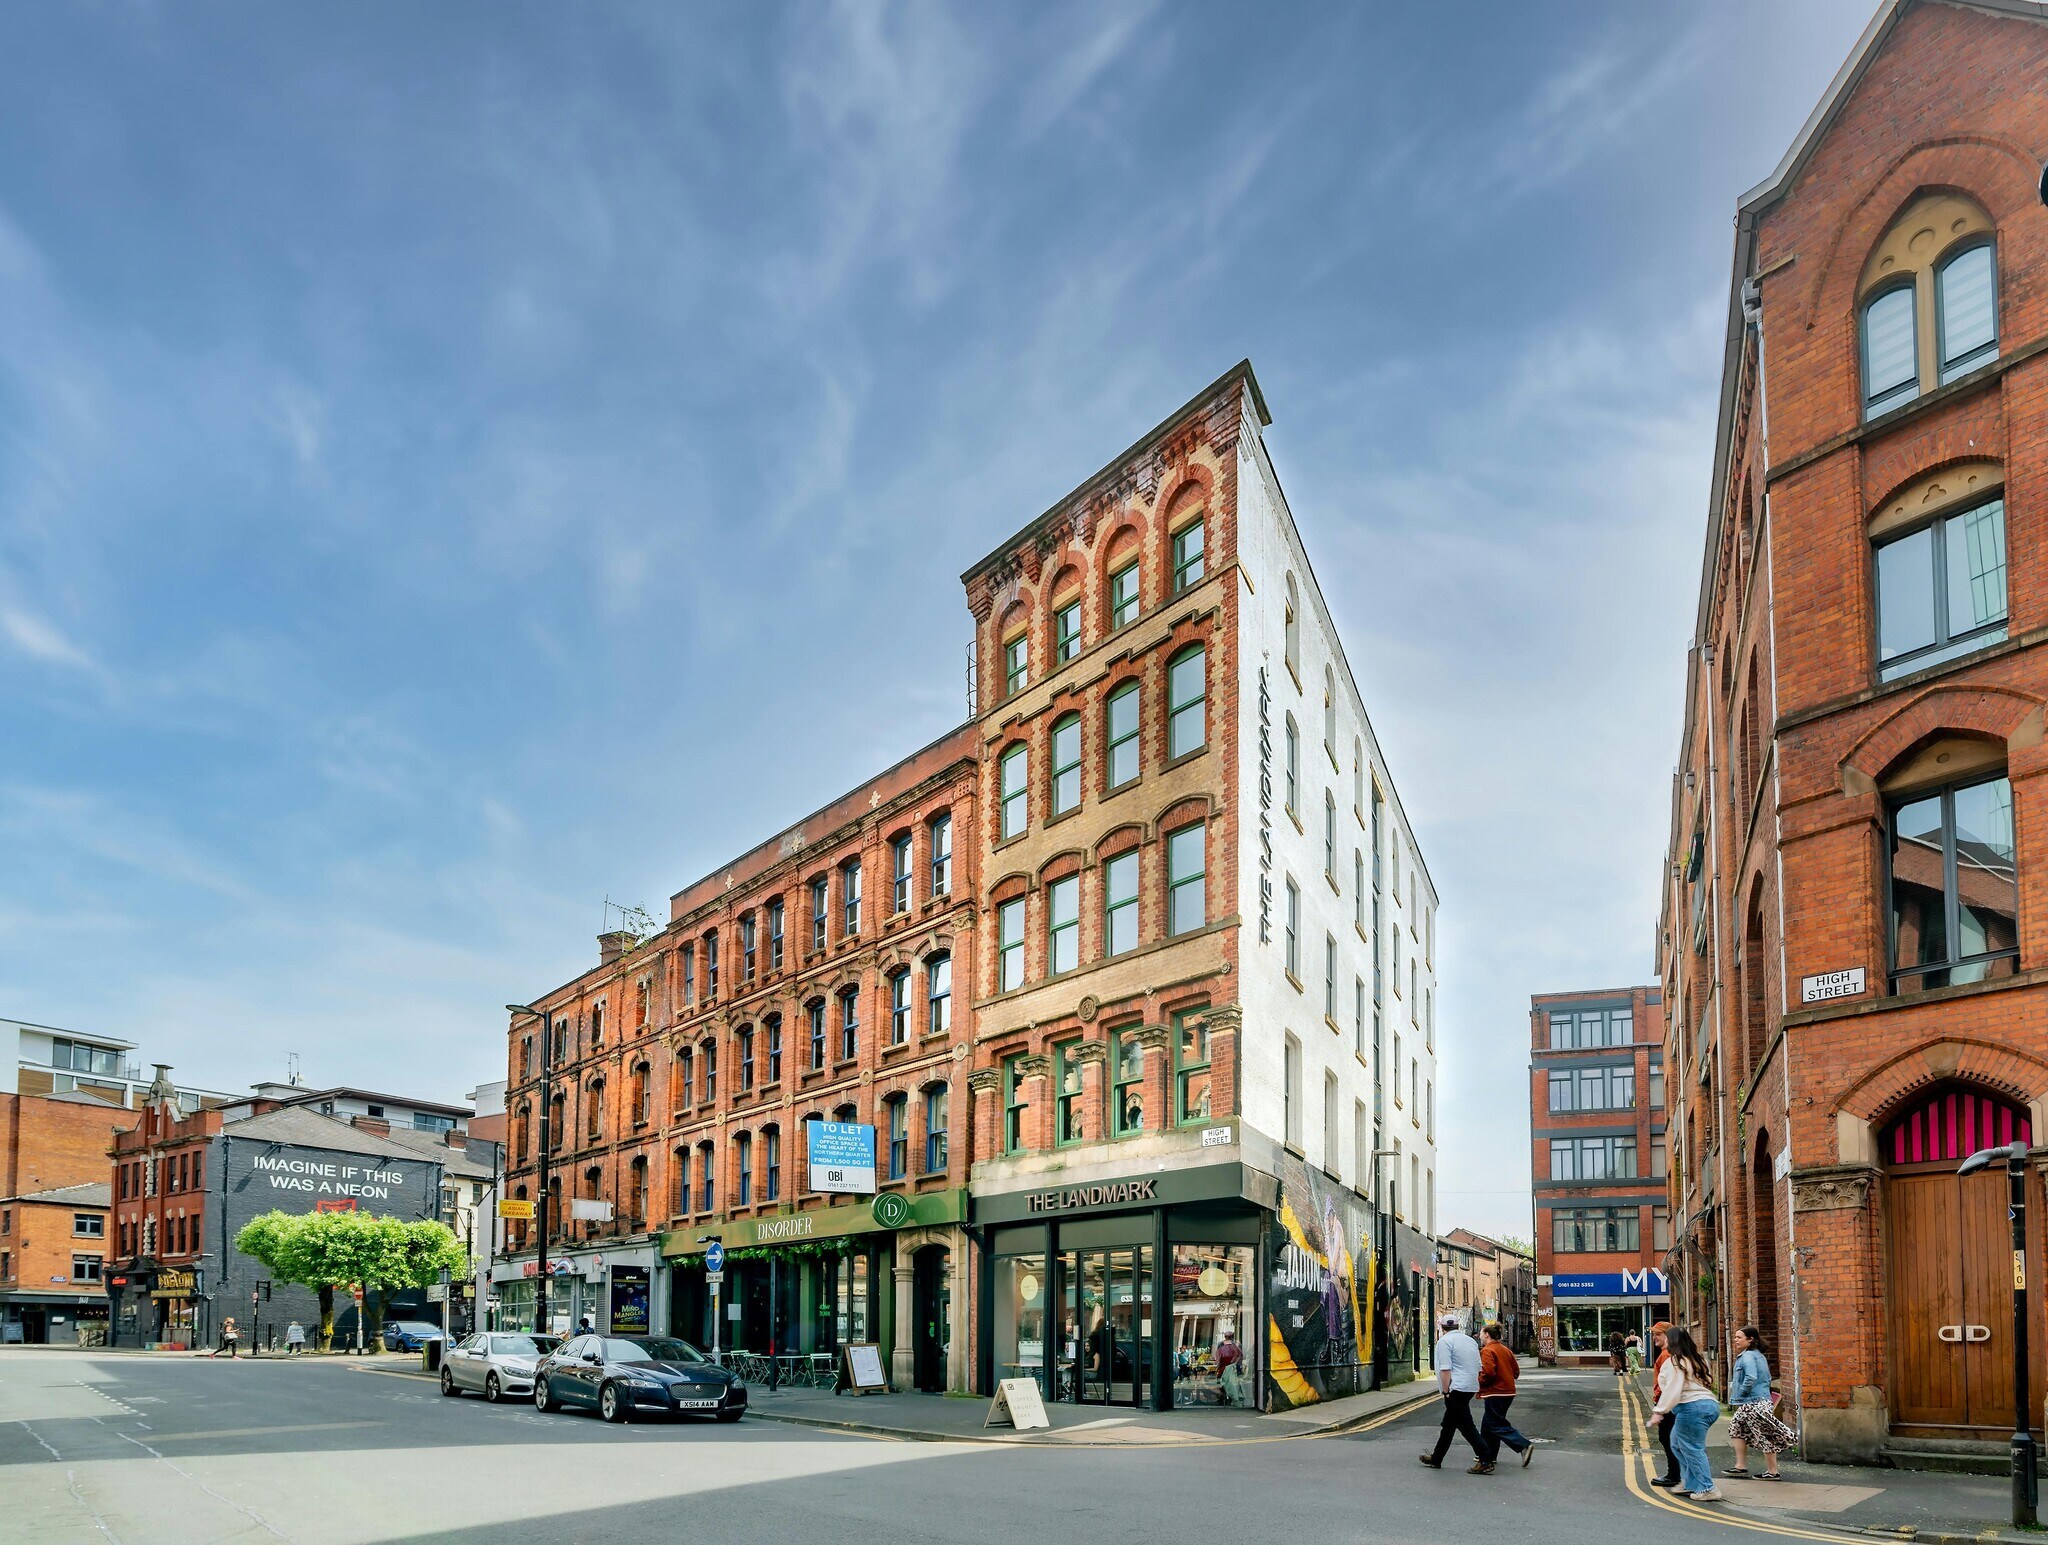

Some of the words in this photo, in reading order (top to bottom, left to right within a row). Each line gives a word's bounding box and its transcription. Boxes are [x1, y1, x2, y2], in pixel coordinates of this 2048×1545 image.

[1258, 664, 1272, 874] LANDMARK
[1258, 873, 1272, 948] THE
[1808, 981, 1859, 1000] STREET
[1816, 971, 1850, 987] HIGH
[821, 1123, 837, 1133] TO
[841, 1124, 863, 1135] LET
[1204, 1135, 1228, 1146] STREET
[1207, 1128, 1225, 1137] HIGH
[253, 1156, 336, 1177] IMAGINE
[342, 1166, 358, 1179] IF
[362, 1168, 403, 1184] THIS
[269, 1175, 315, 1191] WAS
[318, 1181, 332, 1194] A
[336, 1182, 388, 1199] NEON
[1024, 1192, 1057, 1212] THE
[1059, 1179, 1156, 1209] LANDMARK
[887, 1203, 898, 1217] D
[757, 1217, 813, 1240] DISORDER
[1622, 1267, 1669, 1293] MY
